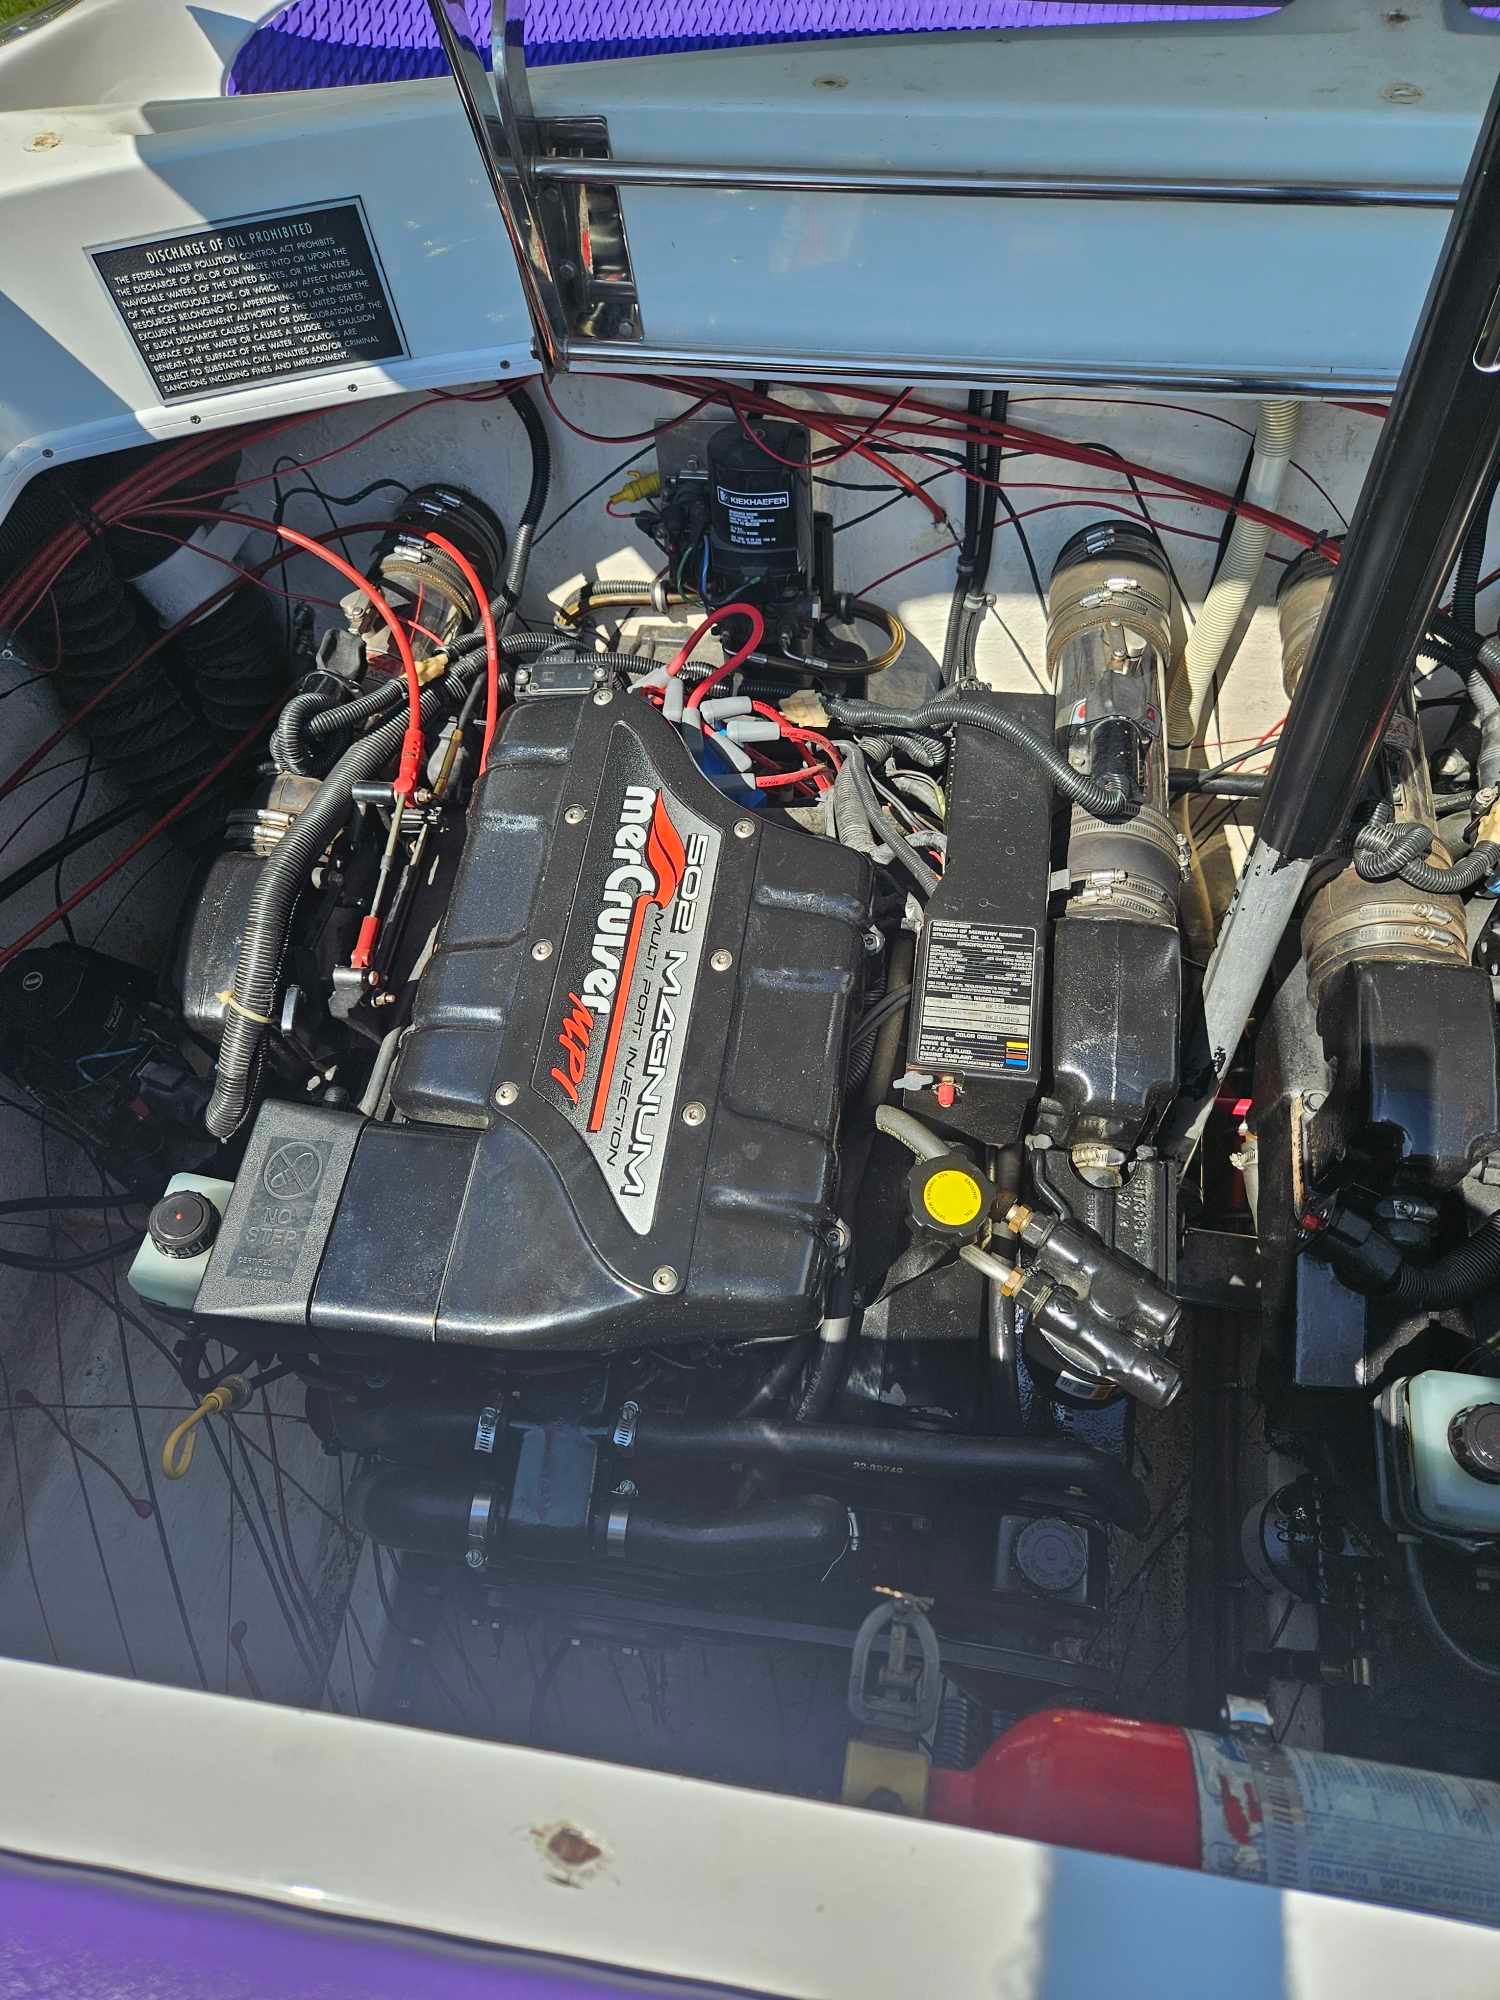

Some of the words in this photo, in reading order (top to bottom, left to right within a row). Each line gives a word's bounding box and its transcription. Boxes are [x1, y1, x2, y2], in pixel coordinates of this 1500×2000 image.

[114, 275, 131, 285] THE
[131, 267, 166, 281] FEDERAL
[165, 262, 193, 274] WATER
[194, 253, 237, 270] POLLUTION
[239, 247, 278, 261] CONTROL
[279, 243, 294, 254] ACT
[296, 237, 335, 250] PROHIBITS
[145, 241, 208, 264] DISCHARGE
[209, 238, 227, 251] OF
[227, 234, 247, 248] OIL
[248, 222, 313, 244] PROHIBITED
[115, 287, 132, 297] THE
[132, 278, 178, 294] DISCHARGE
[193, 273, 208, 282] OIL
[223, 266, 240, 276] OILY
[242, 261, 270, 272] WASTE
[271, 257, 291, 268] INTO
[306, 250, 331, 261] UPON
[332, 247, 348, 256] THE
[121, 293, 166, 309] NAVIGABLE
[166, 287, 197, 299] WATERS
[212, 281, 228, 291] THE
[228, 275, 257, 287] UNITED
[303, 264, 319, 274] THE
[320, 258, 351, 270] WATERS
[140, 307, 156, 317] THE
[158, 296, 210, 313] CONTIGUOUS
[252, 284, 280, 294] WHICH
[282, 279, 298, 290] MAY
[302, 274, 329, 287] AFFECT
[330, 268, 368, 281] NATURAL
[132, 315, 177, 330] RESOURCES
[178, 306, 224, 321] BELONGING
[242, 292, 295, 309] APPERTAINING
[325, 281, 353, 293] UNDER
[355, 279, 371, 288] THE
[137, 326, 178, 341] EXCLUSIVE
[179, 315, 234, 333] MANAGEMENT
[237, 307, 276, 322] AUTHORITY
[290, 302, 307, 311] THE
[309, 297, 337, 308] UNITED
[152, 339, 174, 350] SUCH
[175, 330, 219, 345] DISCHARGE
[220, 324, 250, 336] CAUSES
[260, 319, 277, 329] FILM
[292, 305, 353, 323] DISCOLORATION
[367, 300, 382, 309] THE
[148, 349, 182, 362] SURFACE
[196, 343, 212, 352] THE
[212, 338, 238, 348] WATER
[253, 329, 283, 341] CAUSES
[293, 322, 322, 334] SLUDGE
[337, 312, 376, 326] EMULSION
[153, 359, 188, 372] BENEATH
[188, 356, 204, 365] THE
[205, 349, 238, 362] SURFACE
[252, 344, 267, 352] THE
[300, 330, 341, 343] VIOLATORS
[343, 328, 358, 337] ARE
[159, 370, 189, 383] SUBJECT
[204, 358, 251, 374] SUBSTANTIAL
[252, 354, 271, 364] CIVIL
[272, 347, 309, 360] PENALTIES
[311, 341, 342, 353] AND/OR
[344, 335, 380, 347] CRIMINAL
[164, 378, 208, 393] SANCTIONS
[208, 370, 250, 384] INCLUDING
[251, 365, 272, 375] FINES
[274, 362, 291, 371] AND
[730, 497, 786, 506] KIEKHAEFER
[672, 834, 709, 933] 502
[645, 912, 665, 970] MULTI
[633, 979, 651, 1040] PORT
[551, 991, 594, 1105] MPI
[620, 950, 688, 1197] MAGNUM
[607, 1046, 639, 1167] INJECTION
[245, 1225, 297, 1246] STEP
[264, 1207, 291, 1224] NO
